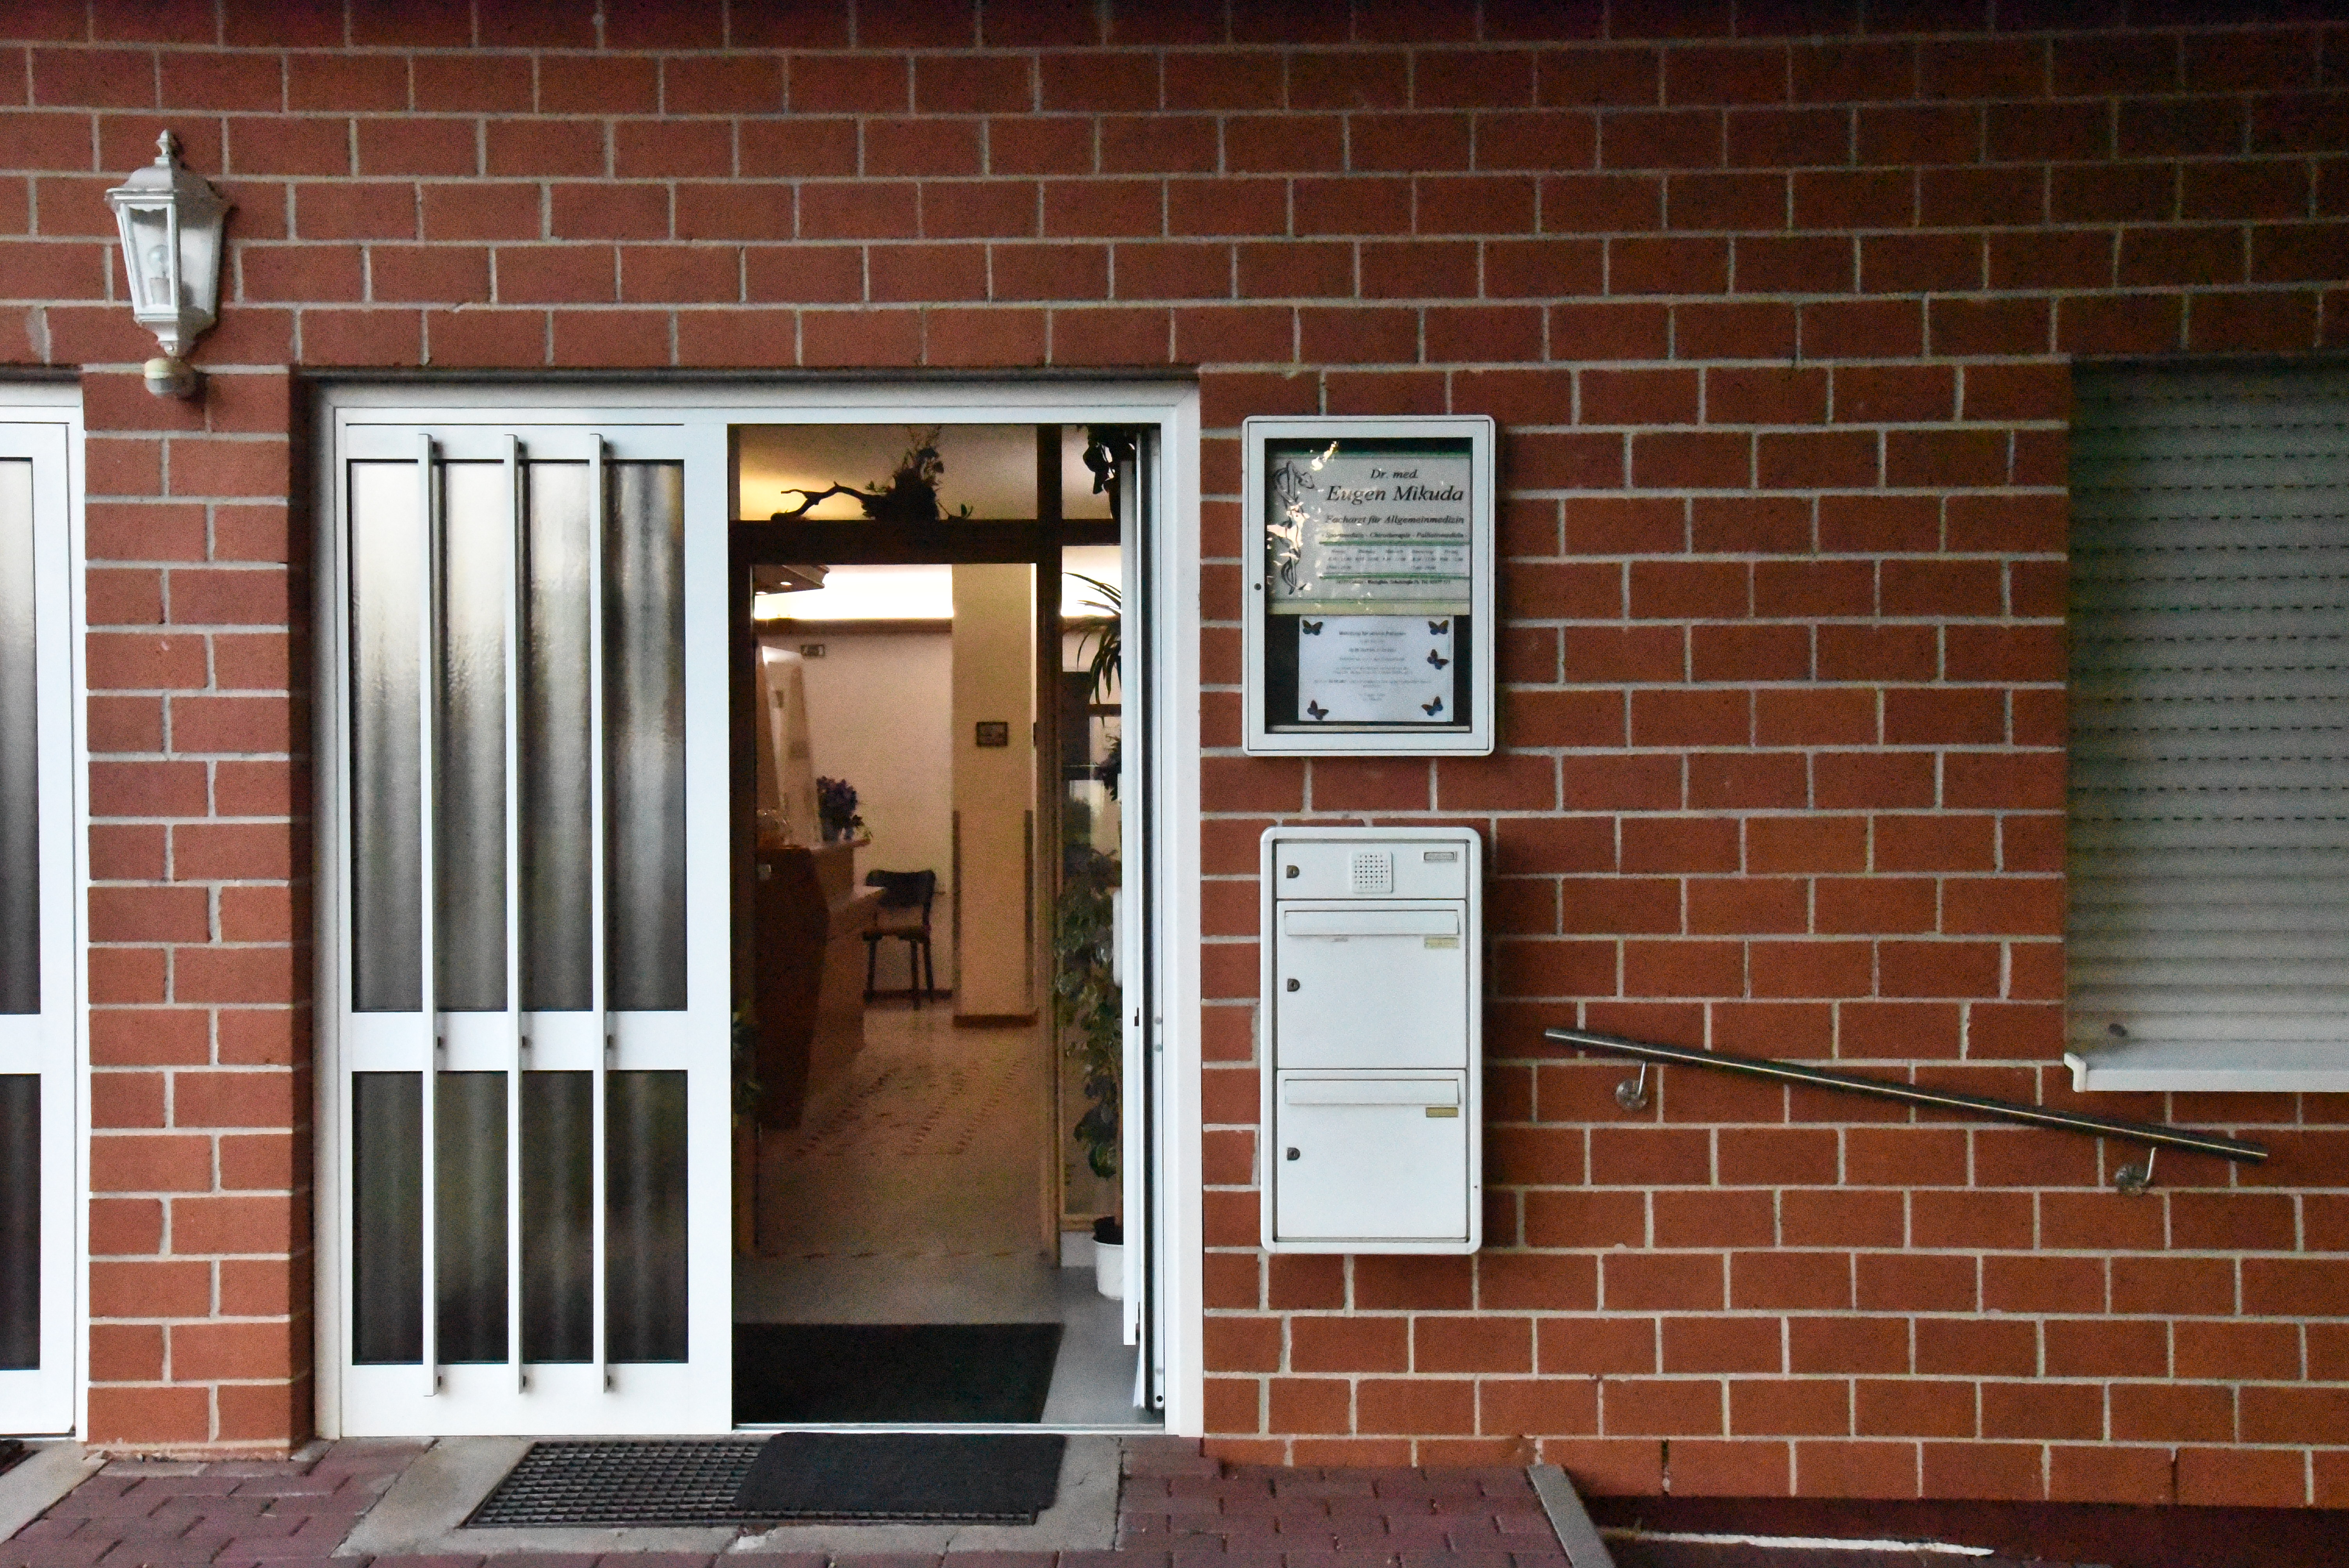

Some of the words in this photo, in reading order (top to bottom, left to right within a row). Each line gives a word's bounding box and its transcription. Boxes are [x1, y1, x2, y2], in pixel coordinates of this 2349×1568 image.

[1327, 485, 1387, 505] Eugen
[1393, 485, 1464, 501] Mikuda
[1326, 515, 1366, 524] Facharzt
[1367, 515, 1381, 525] für
[1384, 514, 1464, 525] Allgemeinmedizin
